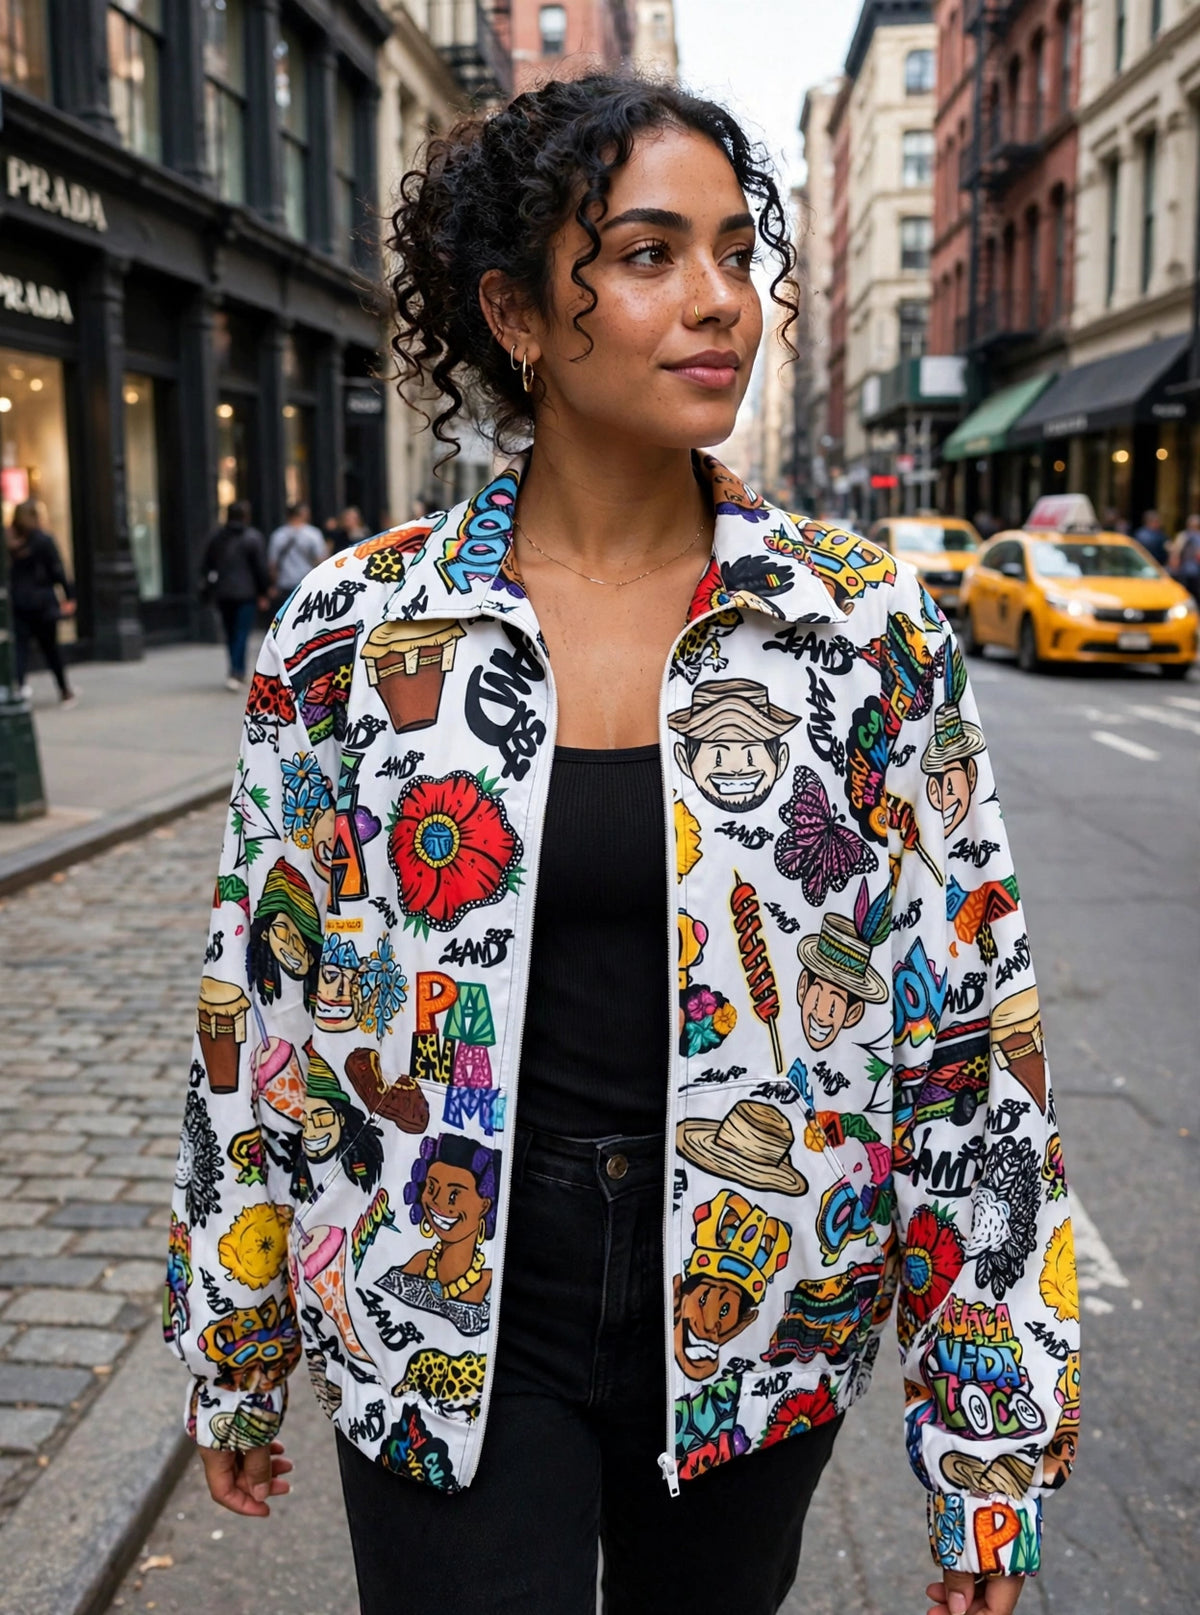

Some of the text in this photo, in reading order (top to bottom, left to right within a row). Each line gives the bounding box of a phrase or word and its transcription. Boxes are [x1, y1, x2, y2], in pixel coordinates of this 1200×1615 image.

[7, 157, 108, 232] PRADA
[863, 770, 883, 806] BLM
[932, 1374, 1044, 1437] LOCO
